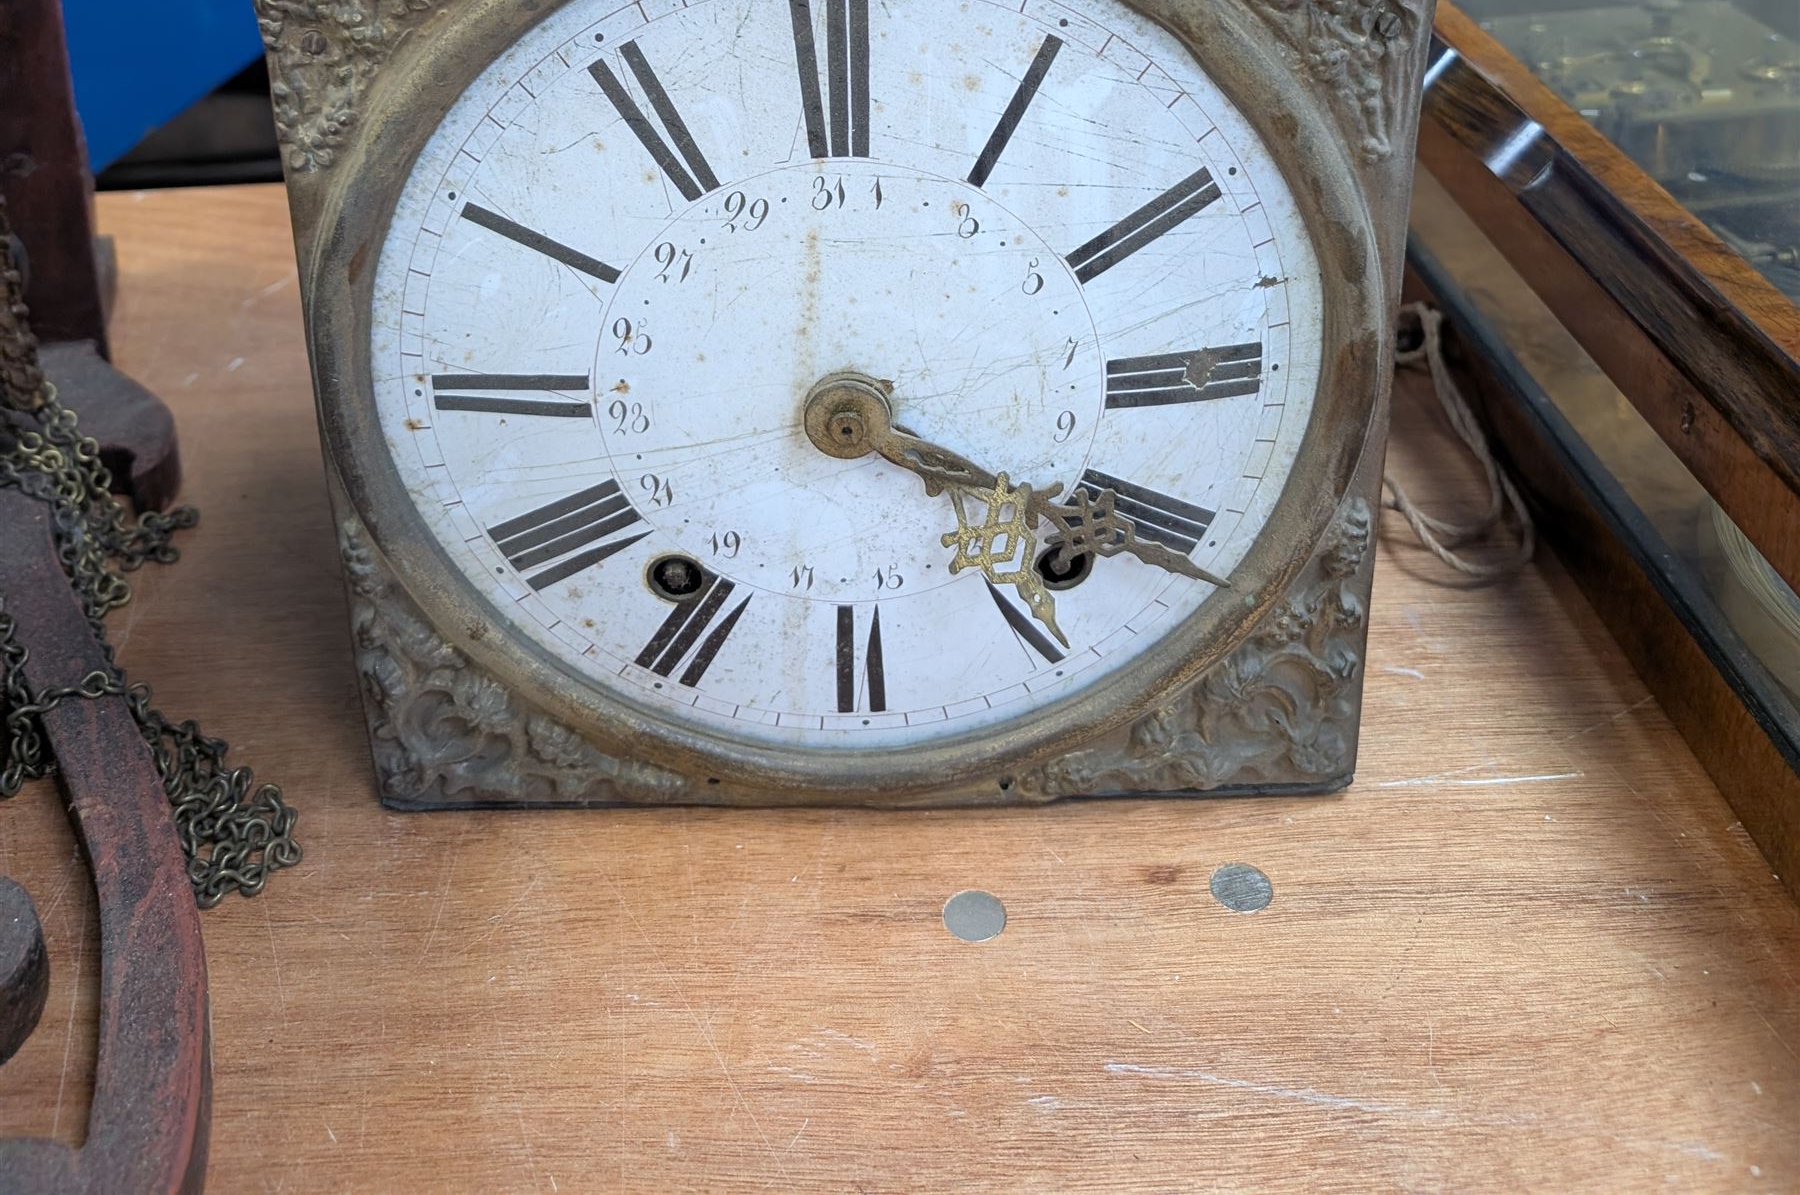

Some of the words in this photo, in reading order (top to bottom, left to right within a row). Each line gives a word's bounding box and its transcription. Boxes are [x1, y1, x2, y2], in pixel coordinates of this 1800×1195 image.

[580, 35, 730, 218] XI
[963, 30, 1068, 192] I
[722, 190, 769, 233] 29
[811, 175, 845, 211] 31
[870, 176, 882, 210] 1
[958, 203, 980, 238] 3
[1063, 165, 1223, 289] II
[654, 242, 693, 284] 27
[1022, 256, 1044, 295] 5
[612, 317, 652, 356] 25
[1061, 336, 1079, 371] 7
[1103, 337, 1262, 413] III
[608, 400, 650, 435] 23
[1053, 410, 1077, 444] 9
[640, 473, 674, 507] 21
[484, 472, 655, 595] VIII
[1062, 468, 1216, 562] III
[706, 530, 741, 559] 19
[789, 564, 815, 591] 17
[873, 562, 904, 590] 15
[829, 603, 890, 713] VI
